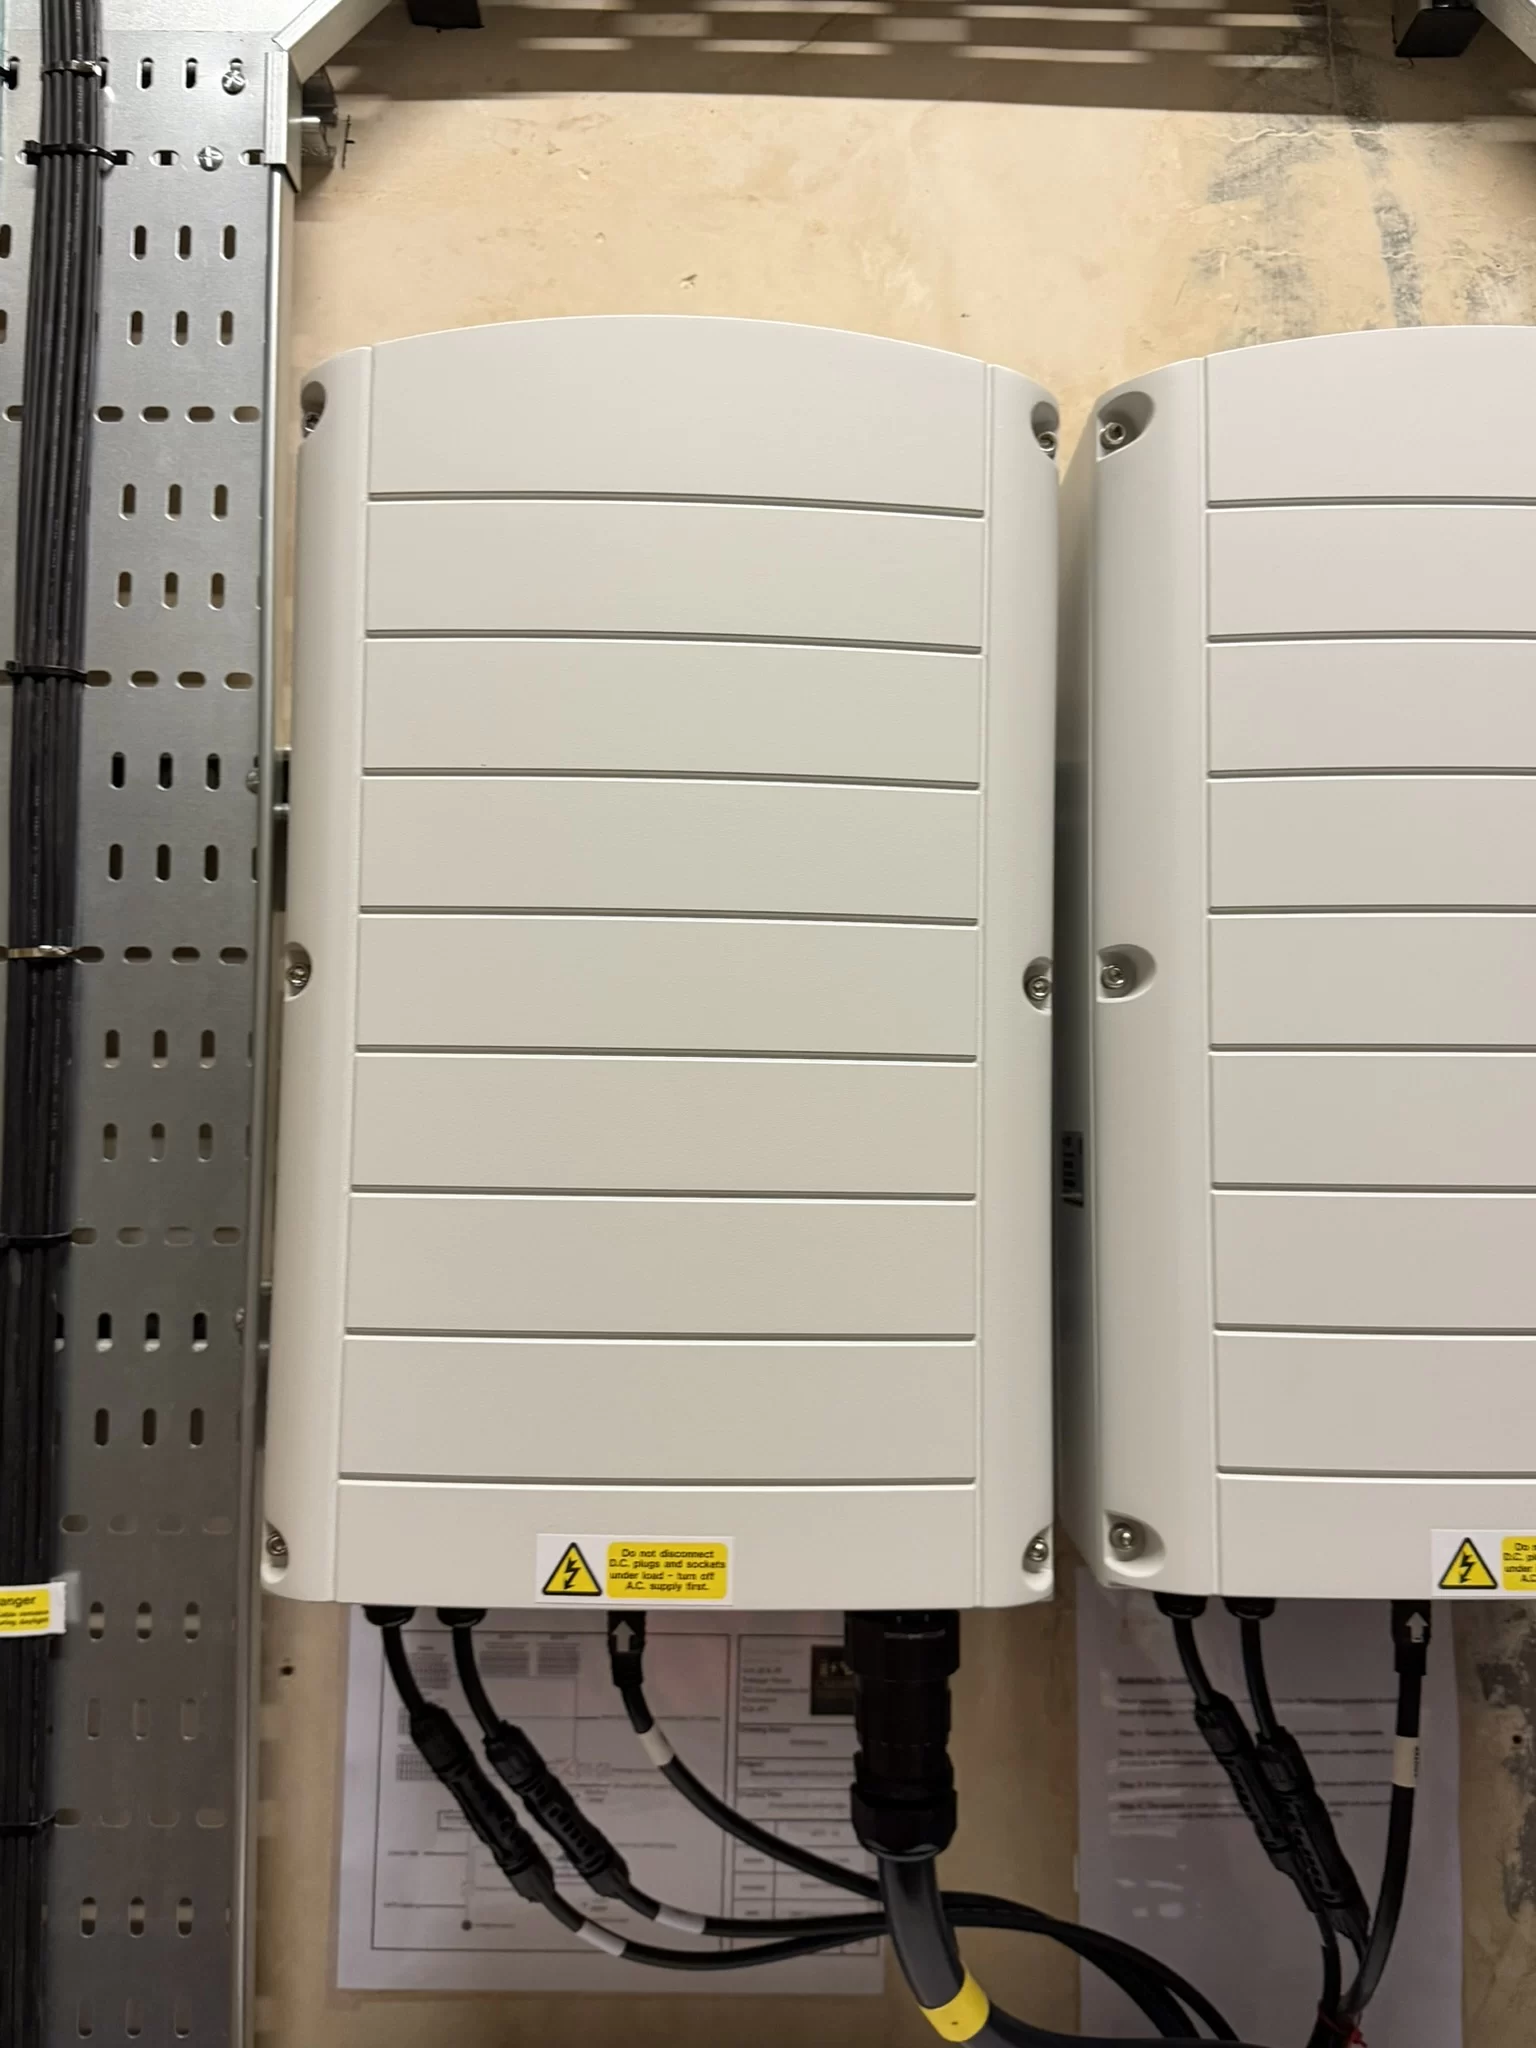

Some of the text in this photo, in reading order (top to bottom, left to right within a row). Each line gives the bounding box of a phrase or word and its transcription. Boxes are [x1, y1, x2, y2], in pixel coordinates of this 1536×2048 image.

[621, 1548, 715, 1558] Do not disconnect
[609, 1558, 726, 1569] D.C. plugs and sockets
[642, 1571, 664, 1580] load
[676, 1572, 697, 1580] turn
[700, 1572, 715, 1580] off
[625, 1581, 710, 1591] A.C. supply first.
